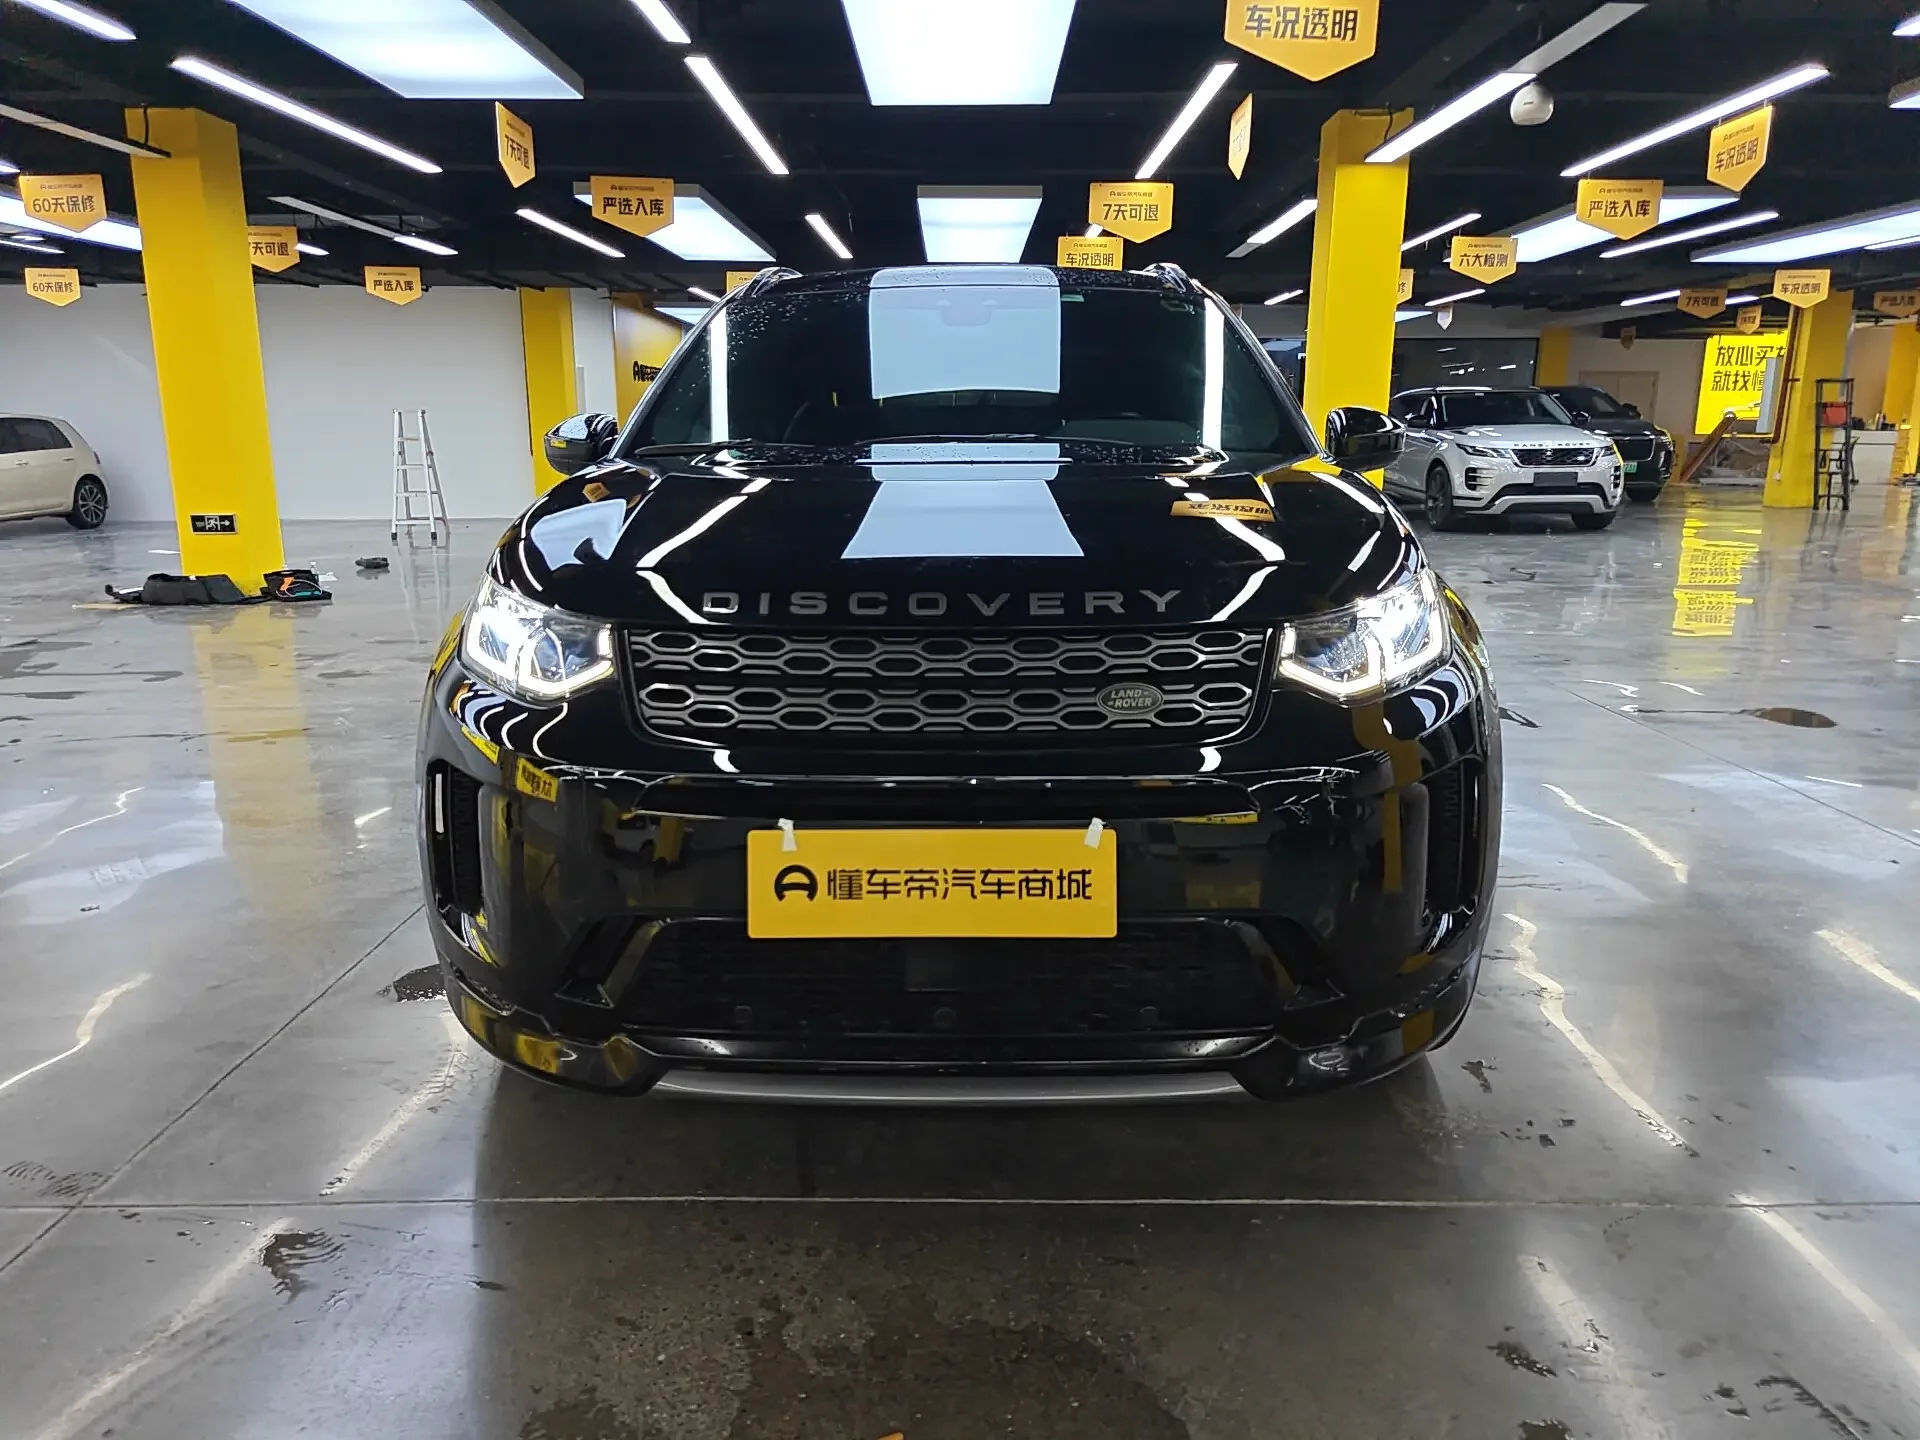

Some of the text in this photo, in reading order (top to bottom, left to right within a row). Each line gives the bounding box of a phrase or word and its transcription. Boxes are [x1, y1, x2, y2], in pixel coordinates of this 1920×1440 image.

[1245, 4, 1358, 41] 车况透明
[504, 134, 530, 170] 7天可退
[1715, 137, 1760, 172] 车况透明
[32, 196, 96, 213] 60天保修
[602, 197, 664, 216] 严选入库
[1102, 204, 1159, 221] 7天可退
[1587, 199, 1651, 218] 严选入库
[249, 241, 289, 256] 天可退
[1066, 253, 1114, 266] 车况透明
[1459, 253, 1508, 267] 六大检测
[33, 282, 74, 293] 60天保修
[373, 280, 414, 291] 严选入库
[1780, 282, 1821, 295] 车况透明
[701, 589, 1182, 616] DISCOVERY
[827, 867, 1093, 901] 懂车帝汽车商城
